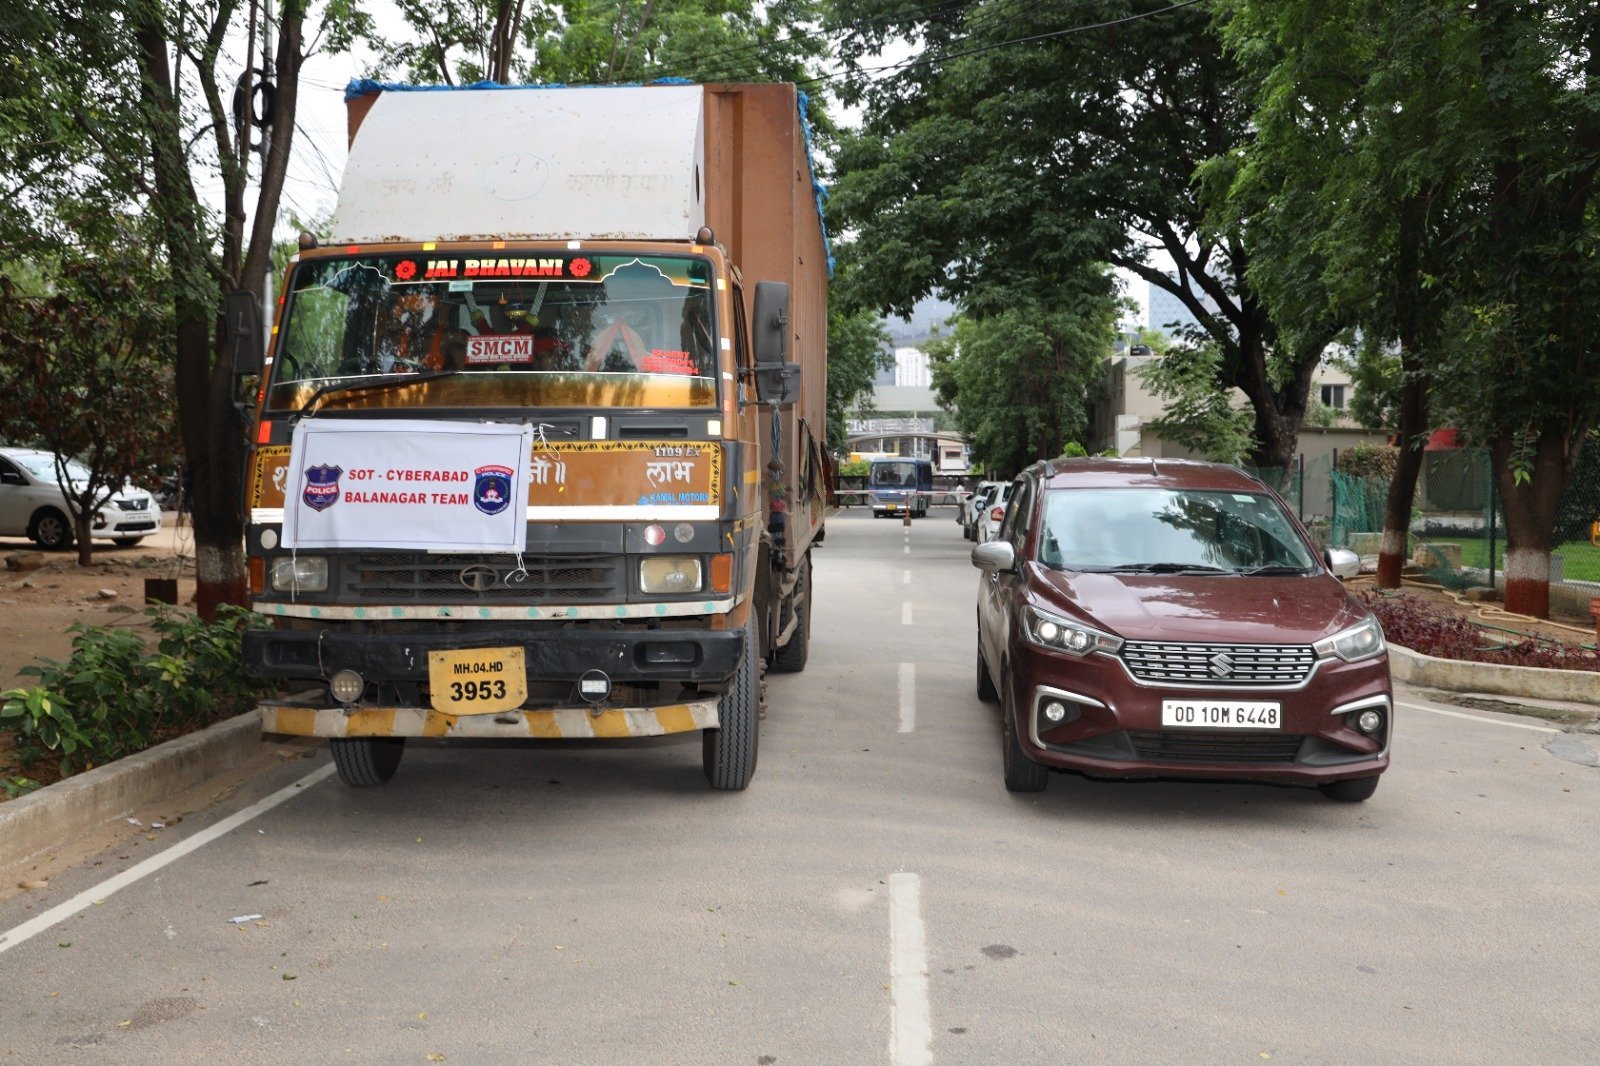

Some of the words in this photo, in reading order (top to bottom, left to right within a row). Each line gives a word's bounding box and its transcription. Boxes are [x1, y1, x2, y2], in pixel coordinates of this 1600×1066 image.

[425, 259, 458, 278] JAI
[464, 258, 564, 277] BHAVANI
[471, 340, 530, 356] SMCM
[655, 447, 682, 457] 1109
[348, 469, 375, 481] SOT
[386, 469, 469, 482] CYBERABAD
[646, 461, 695, 488] लाभ
[307, 486, 337, 494] POLICE
[678, 492, 710, 502] MOTORS
[344, 492, 427, 505] BALANAGAR
[431, 492, 469, 506] TEAM
[453, 660, 504, 675] MH.04.HD
[450, 680, 507, 703] 3953
[1175, 706, 1196, 723] OD
[1201, 706, 1230, 724] 10M
[1236, 706, 1278, 725] 6448
